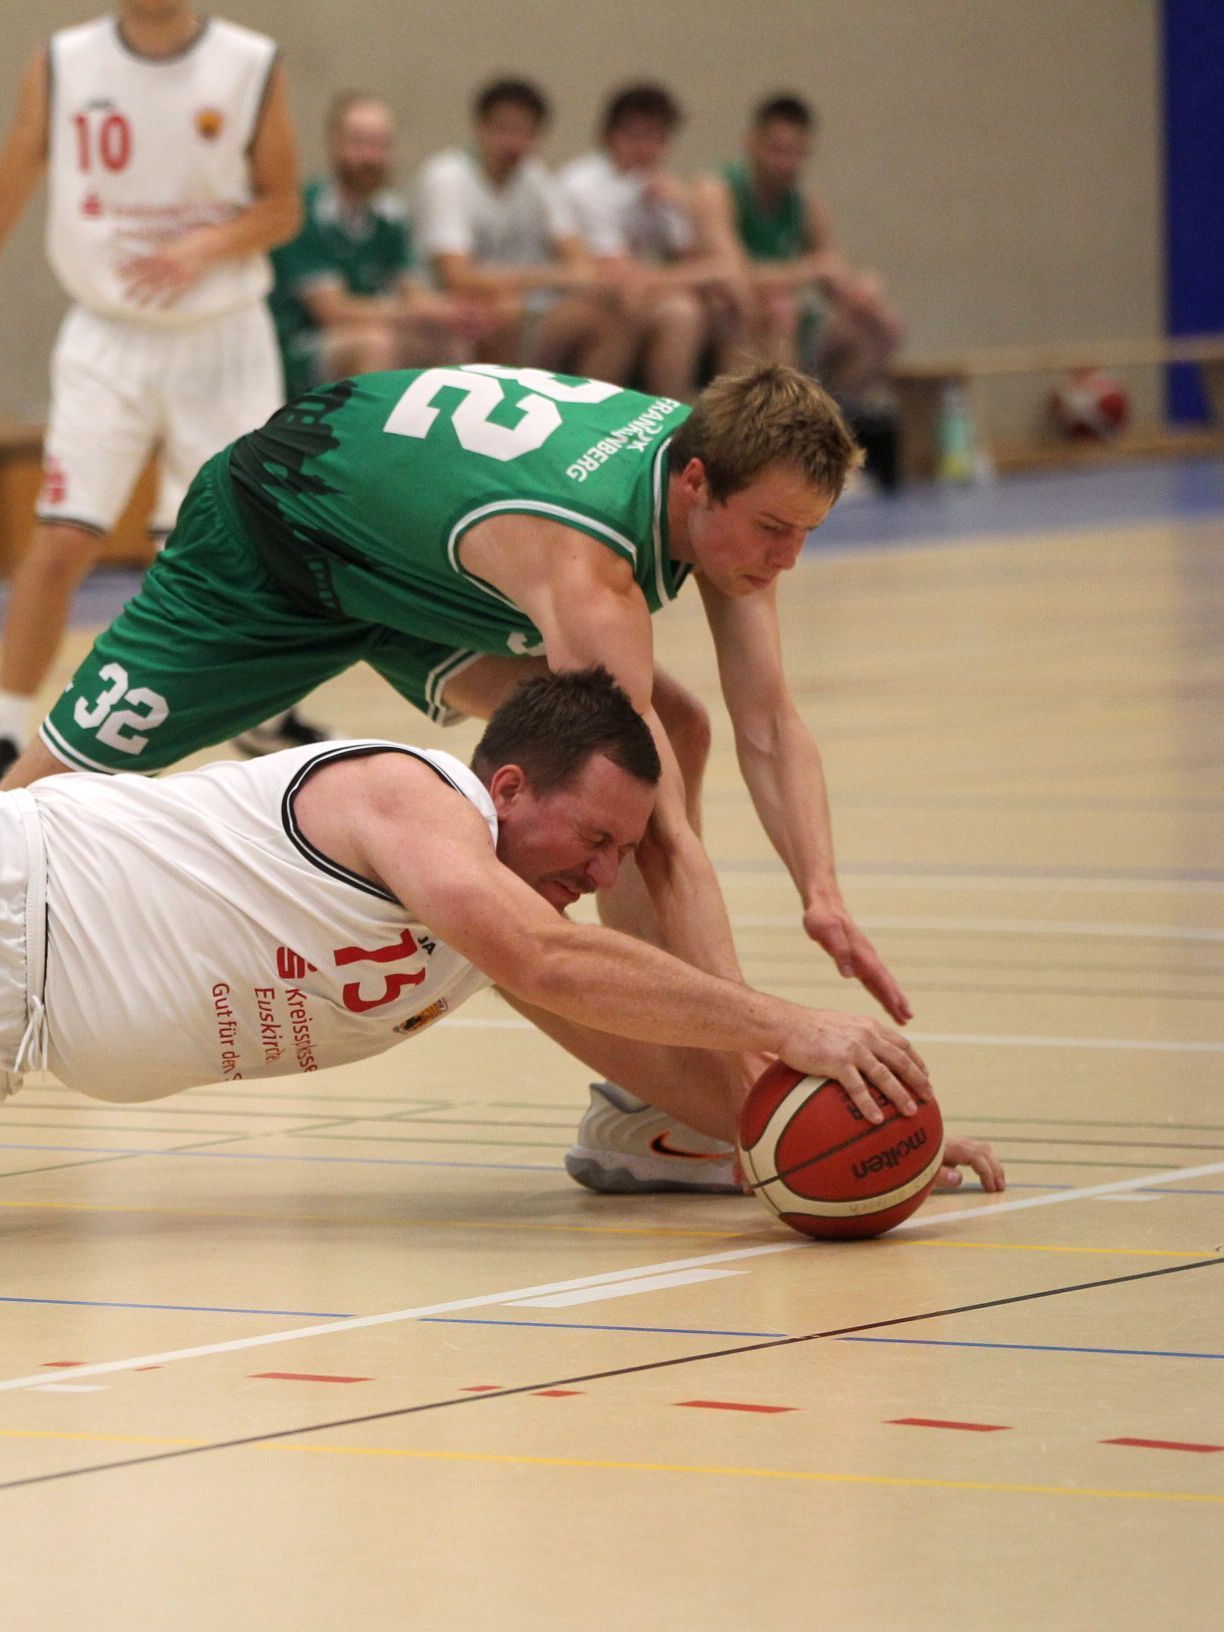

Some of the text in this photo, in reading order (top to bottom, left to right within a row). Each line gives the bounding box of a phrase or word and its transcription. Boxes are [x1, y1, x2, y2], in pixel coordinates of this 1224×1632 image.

[73, 113, 132, 174] 10
[73, 662, 170, 755] 32
[212, 983, 233, 1017] Gut
[218, 1021, 237, 1046] für
[222, 1051, 240, 1074] den
[851, 1128, 927, 1179] molten
